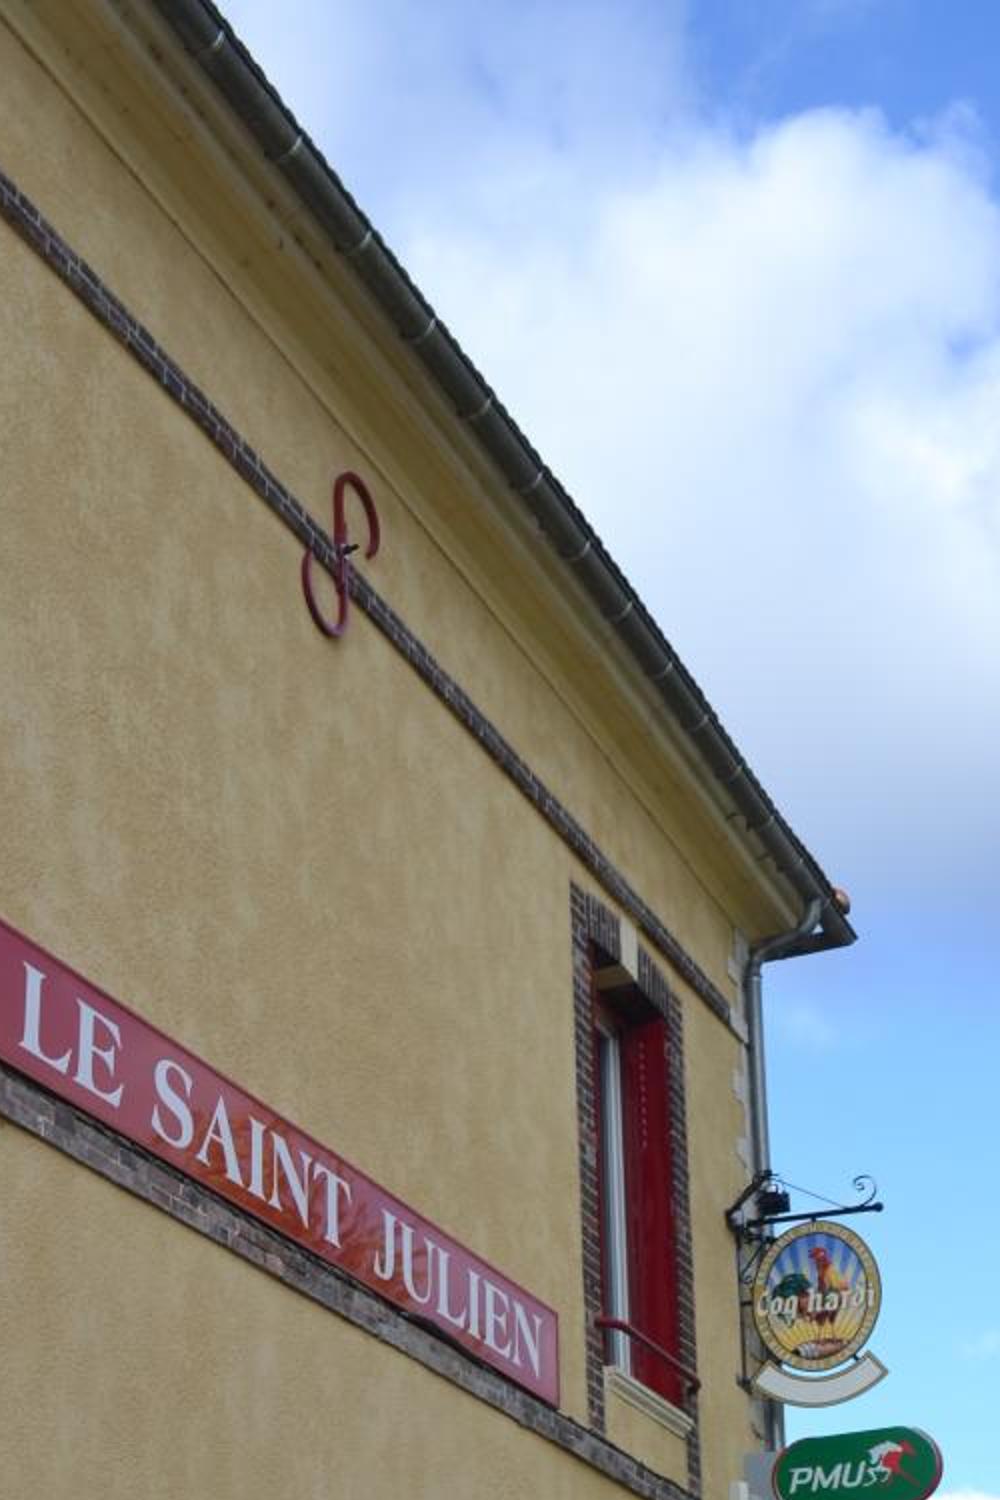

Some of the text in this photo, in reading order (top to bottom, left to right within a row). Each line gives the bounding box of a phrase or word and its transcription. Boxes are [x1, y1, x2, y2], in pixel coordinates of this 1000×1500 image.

[18, 961, 544, 1378] LE SAINT JULIEN
[789, 1461, 866, 1494] PMU
